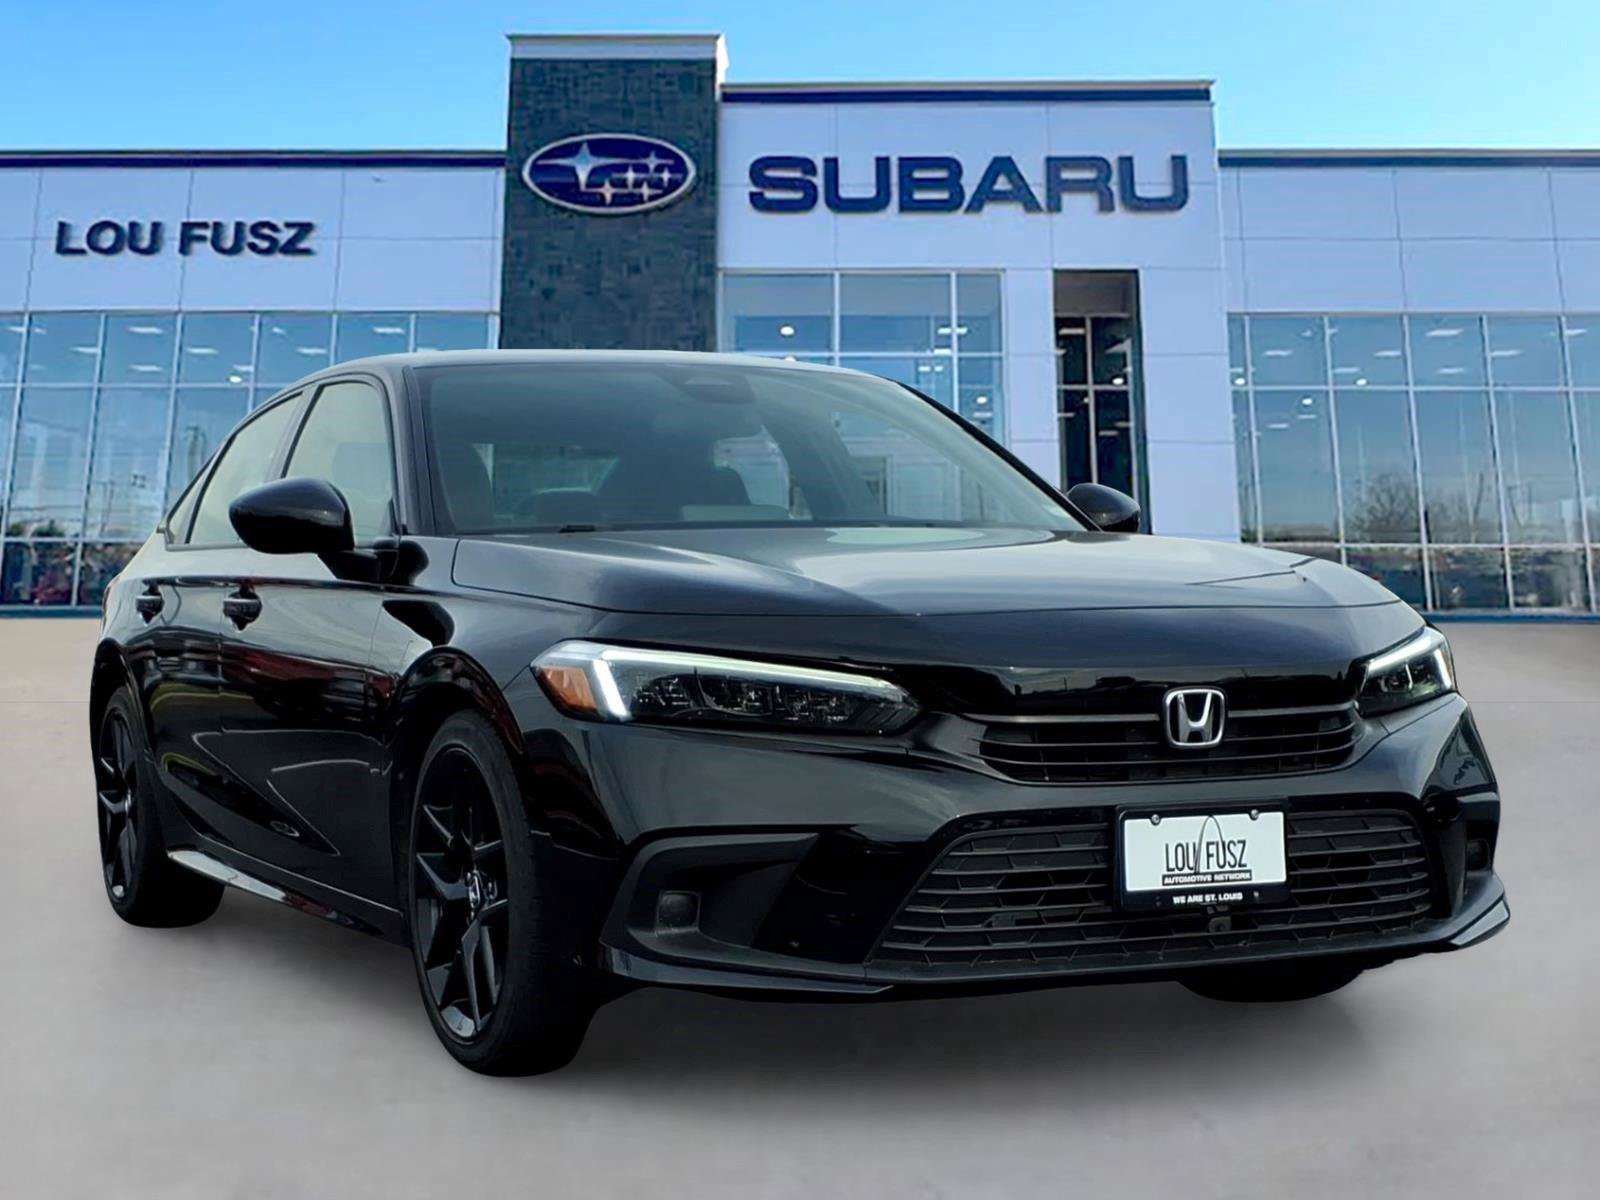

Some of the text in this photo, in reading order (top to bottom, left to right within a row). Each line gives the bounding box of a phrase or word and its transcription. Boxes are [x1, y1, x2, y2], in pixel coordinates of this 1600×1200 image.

[748, 155, 1189, 213] SUBARU
[55, 220, 316, 256] LOU FUSZ
[1165, 840, 1247, 872] LOU FUSZ
[1164, 872, 1250, 884] AUTOMOTIVE NETWORK
[1173, 892, 1243, 904] WE ARE ST. LOUIS
